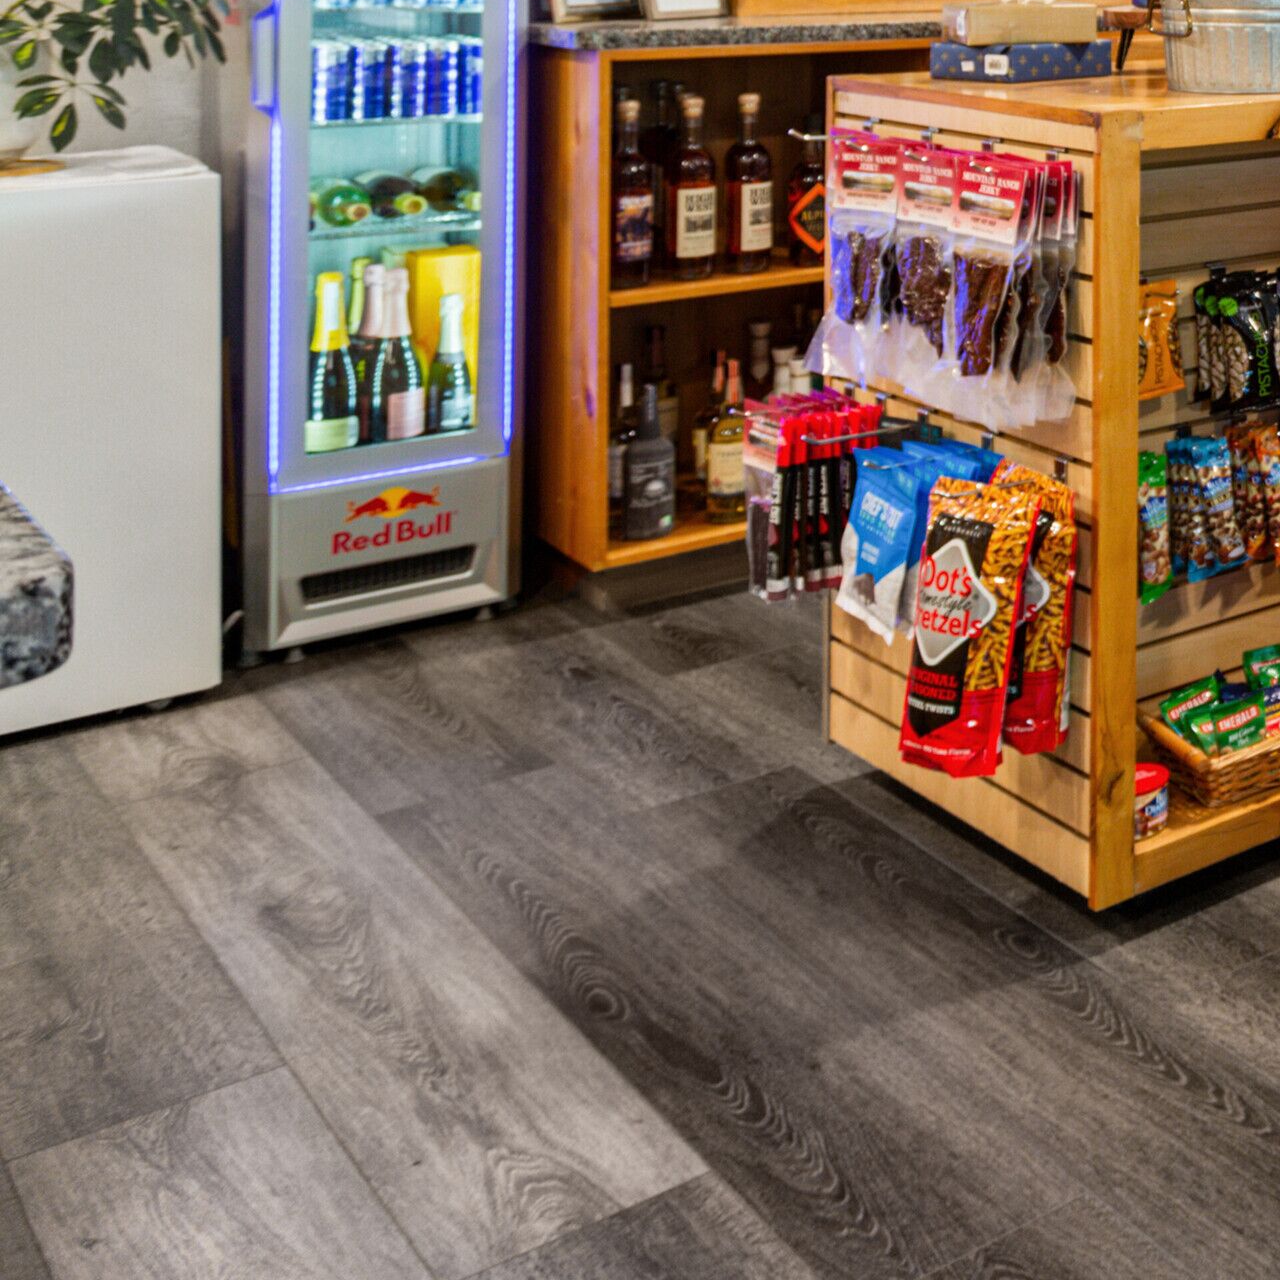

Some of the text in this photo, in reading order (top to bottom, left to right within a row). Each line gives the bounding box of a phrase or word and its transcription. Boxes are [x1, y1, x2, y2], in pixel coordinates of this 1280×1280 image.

[997, 179, 1020, 191] RANCH
[330, 510, 452, 556] Red Bull
[922, 557, 972, 597] Dot's
[1217, 706, 1258, 732] EMERALD
